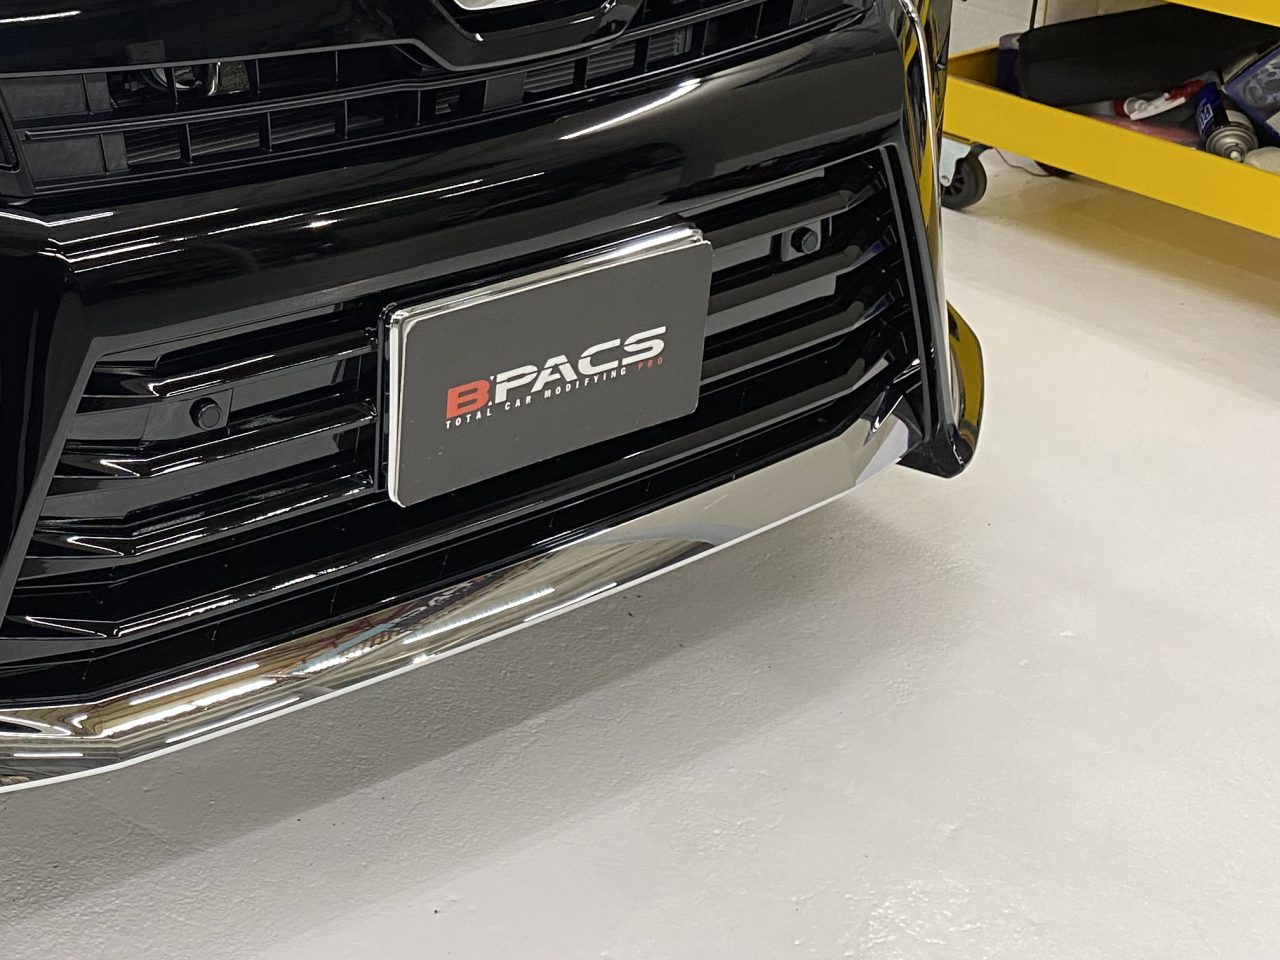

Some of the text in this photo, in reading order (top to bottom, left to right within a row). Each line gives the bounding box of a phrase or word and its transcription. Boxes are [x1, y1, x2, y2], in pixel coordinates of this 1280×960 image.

[446, 356, 664, 430] TOTAL CAR MODIFYING PRO
